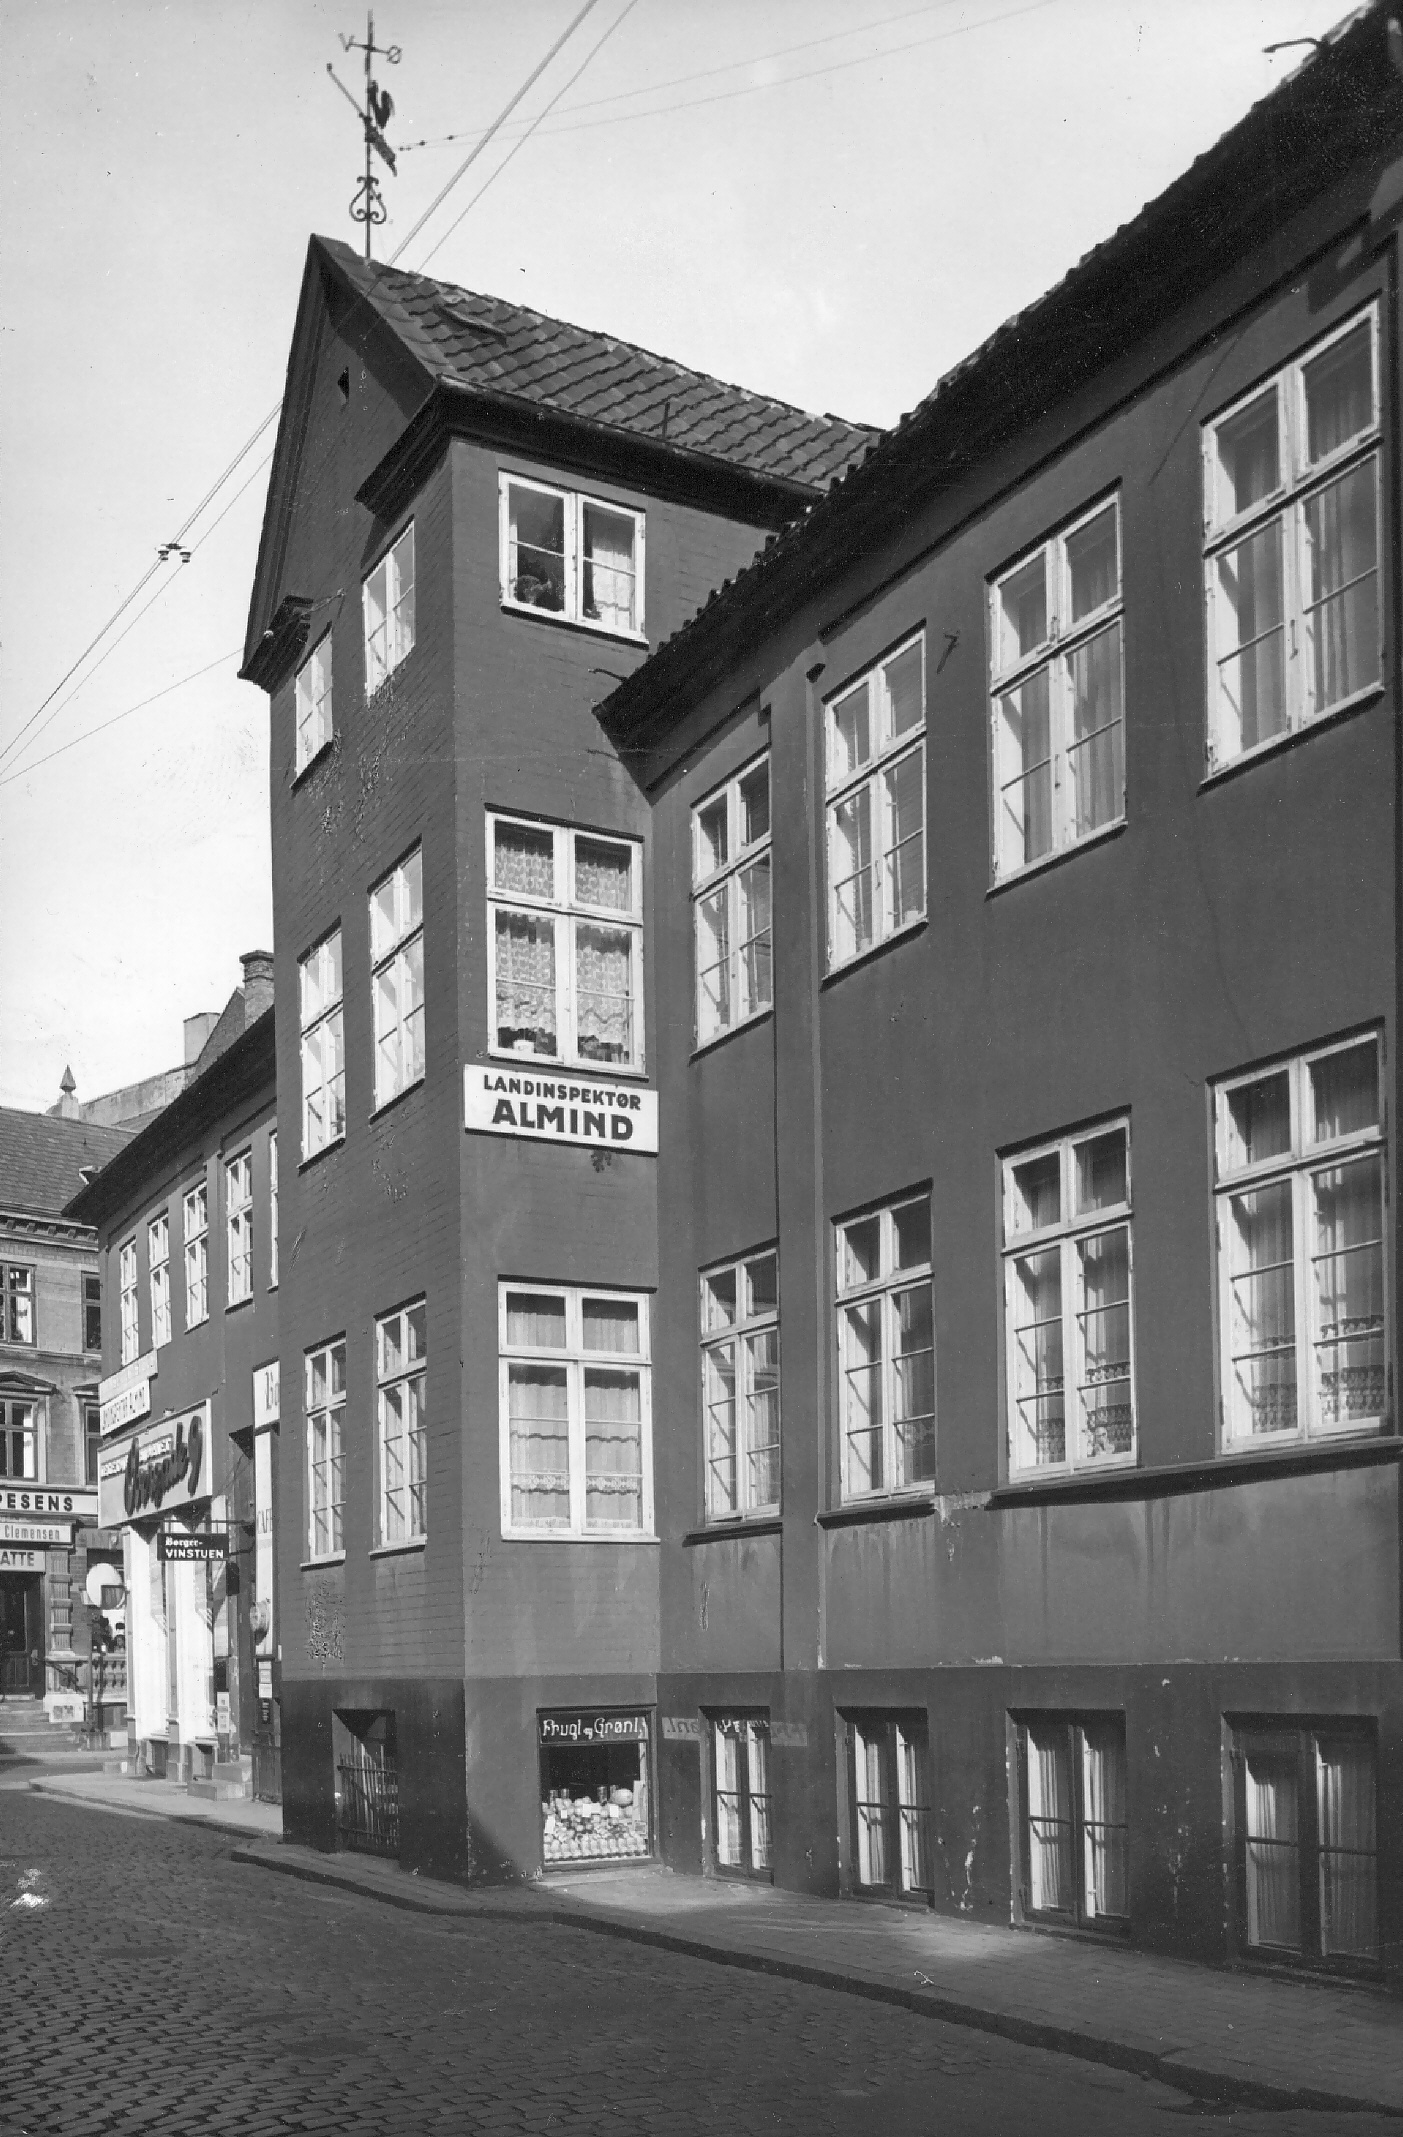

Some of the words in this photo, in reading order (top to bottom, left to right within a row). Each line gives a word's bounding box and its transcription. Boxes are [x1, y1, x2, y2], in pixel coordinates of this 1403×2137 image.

[483, 1074, 641, 1111] LANDINSPEKTØR
[492, 1099, 634, 1141] ALMIND
[0, 1492, 73, 1512] ESENS
[4, 1524, 60, 1541] Clemensen
[165, 1549, 224, 1559] VINSTUEN
